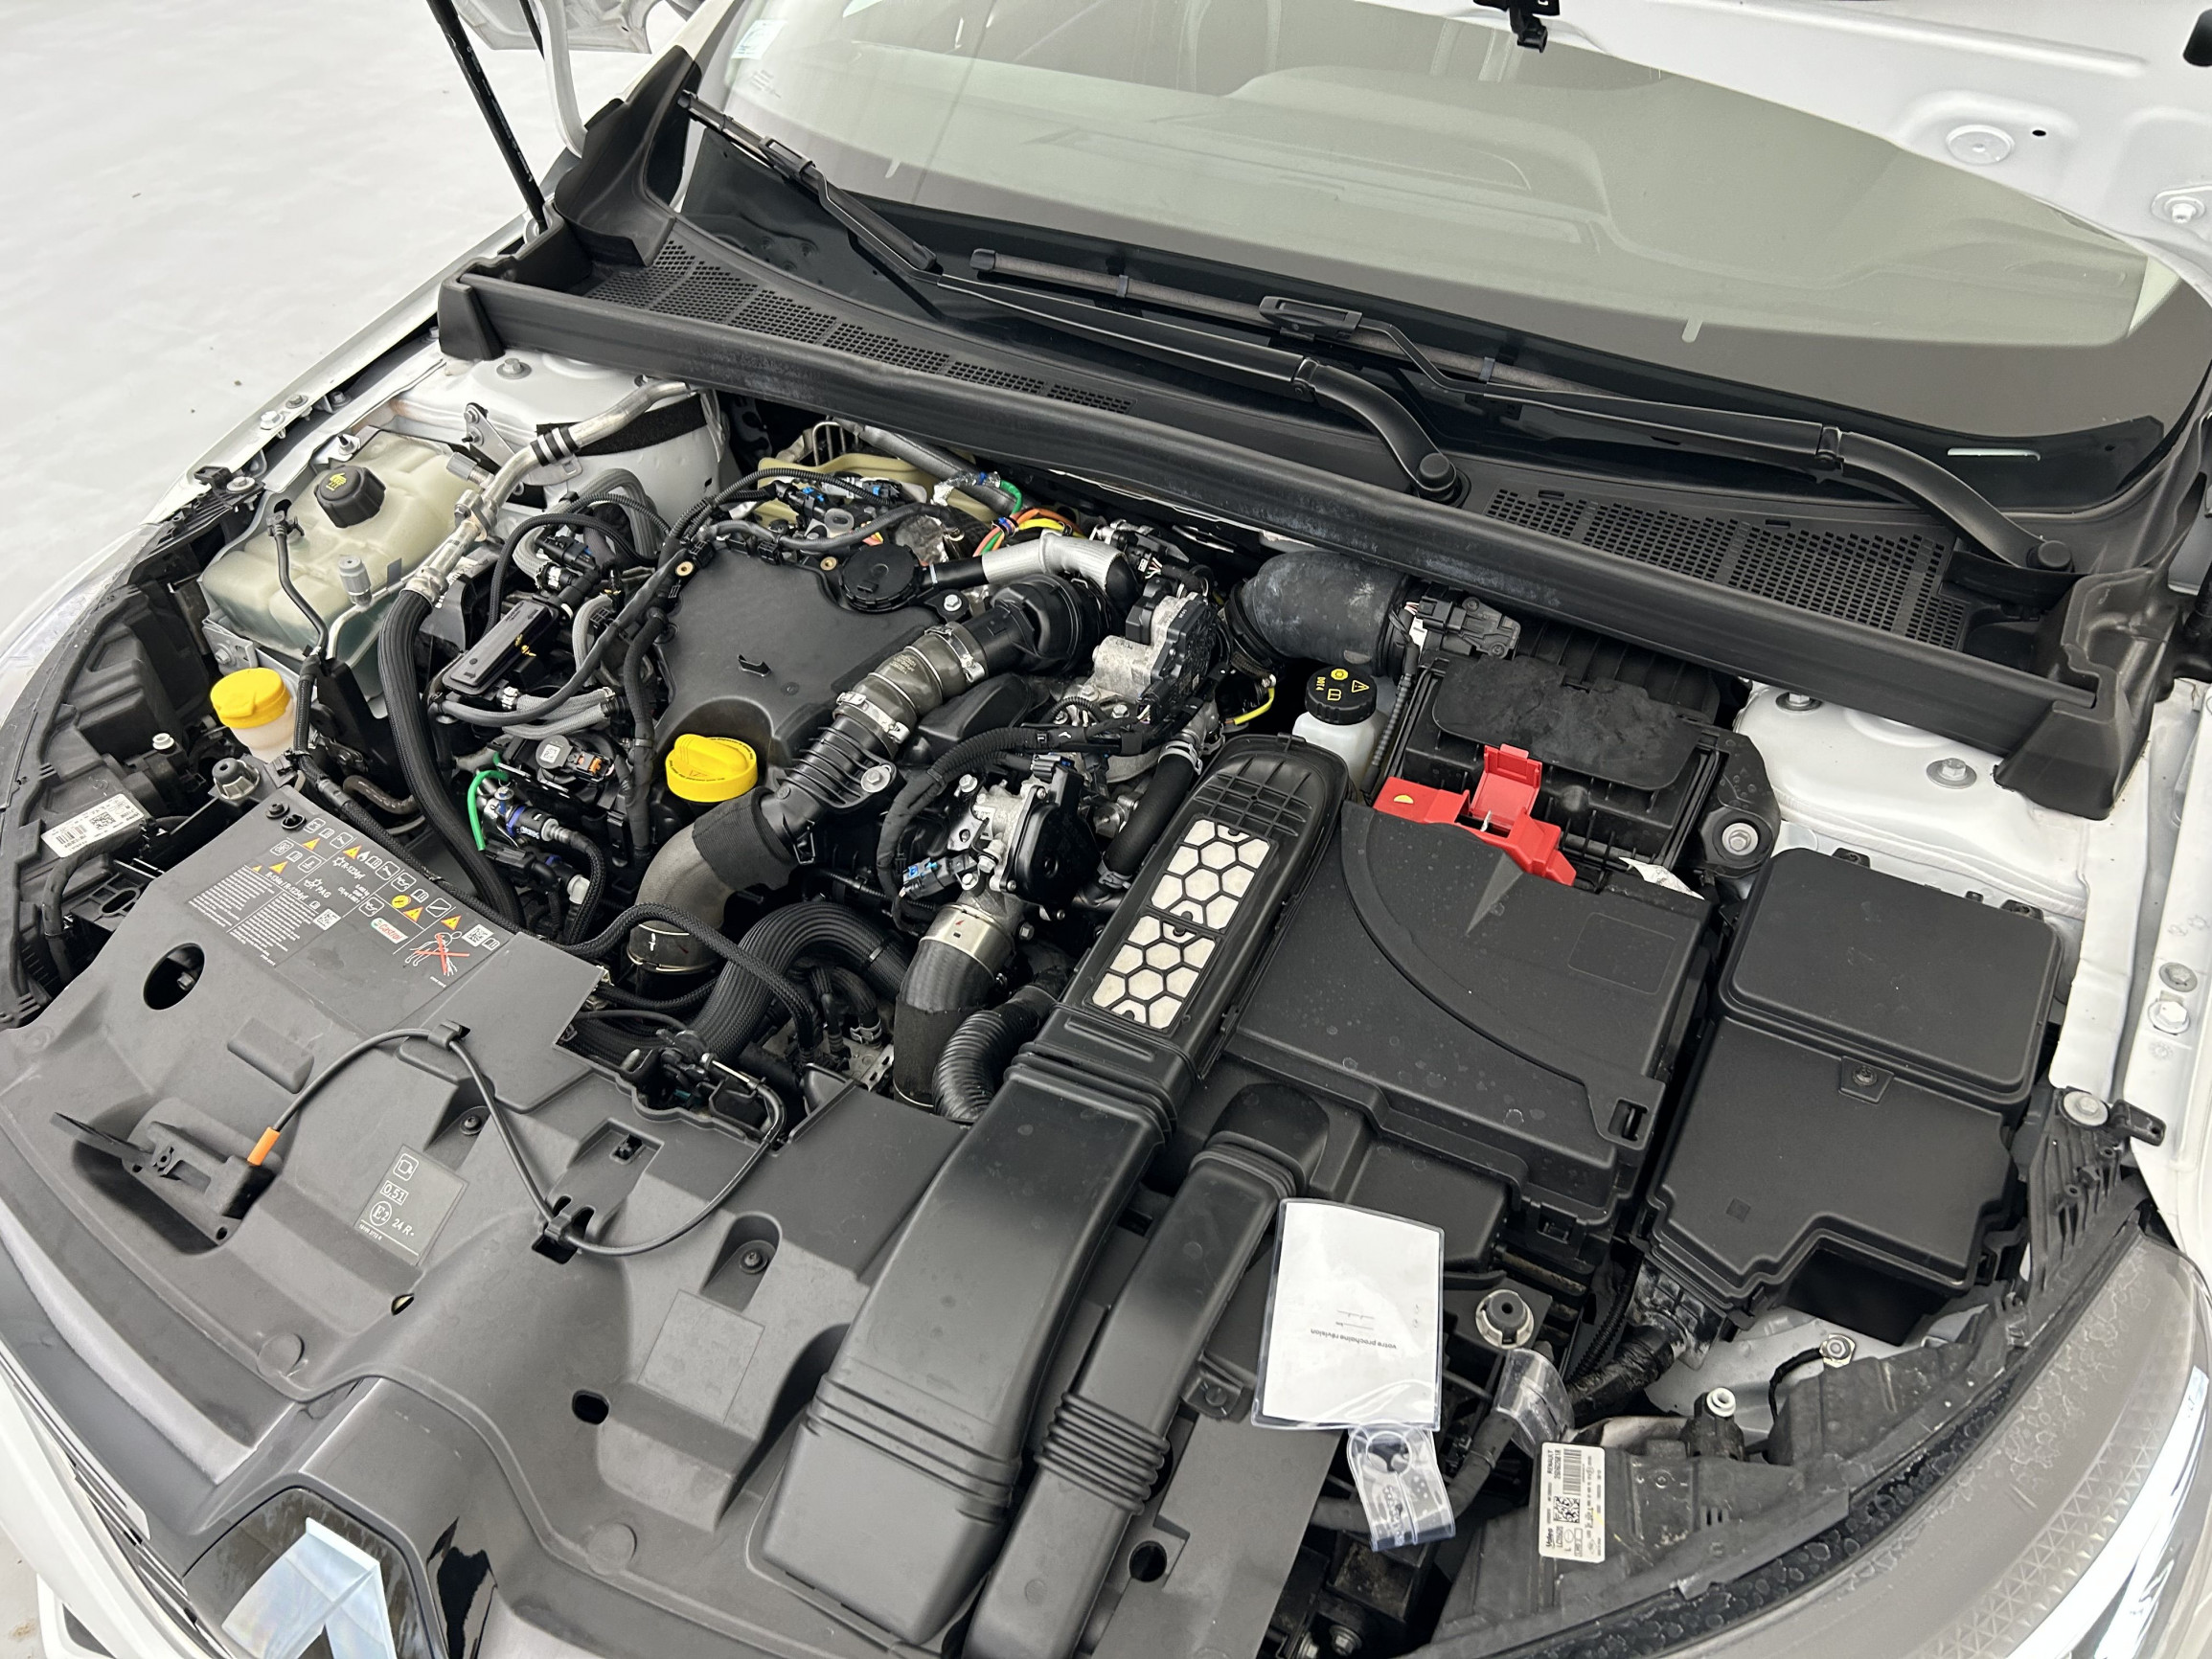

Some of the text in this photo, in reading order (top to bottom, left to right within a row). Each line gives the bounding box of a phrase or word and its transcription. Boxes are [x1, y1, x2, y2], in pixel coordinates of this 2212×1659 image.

[315, 885, 331, 898] PAG
[378, 922, 402, 941] Castrol
[392, 1217, 404, 1230] 24
[1310, 1328, 1397, 1350] votre prochaine révision
[1545, 1528, 1554, 1548] Valeo
